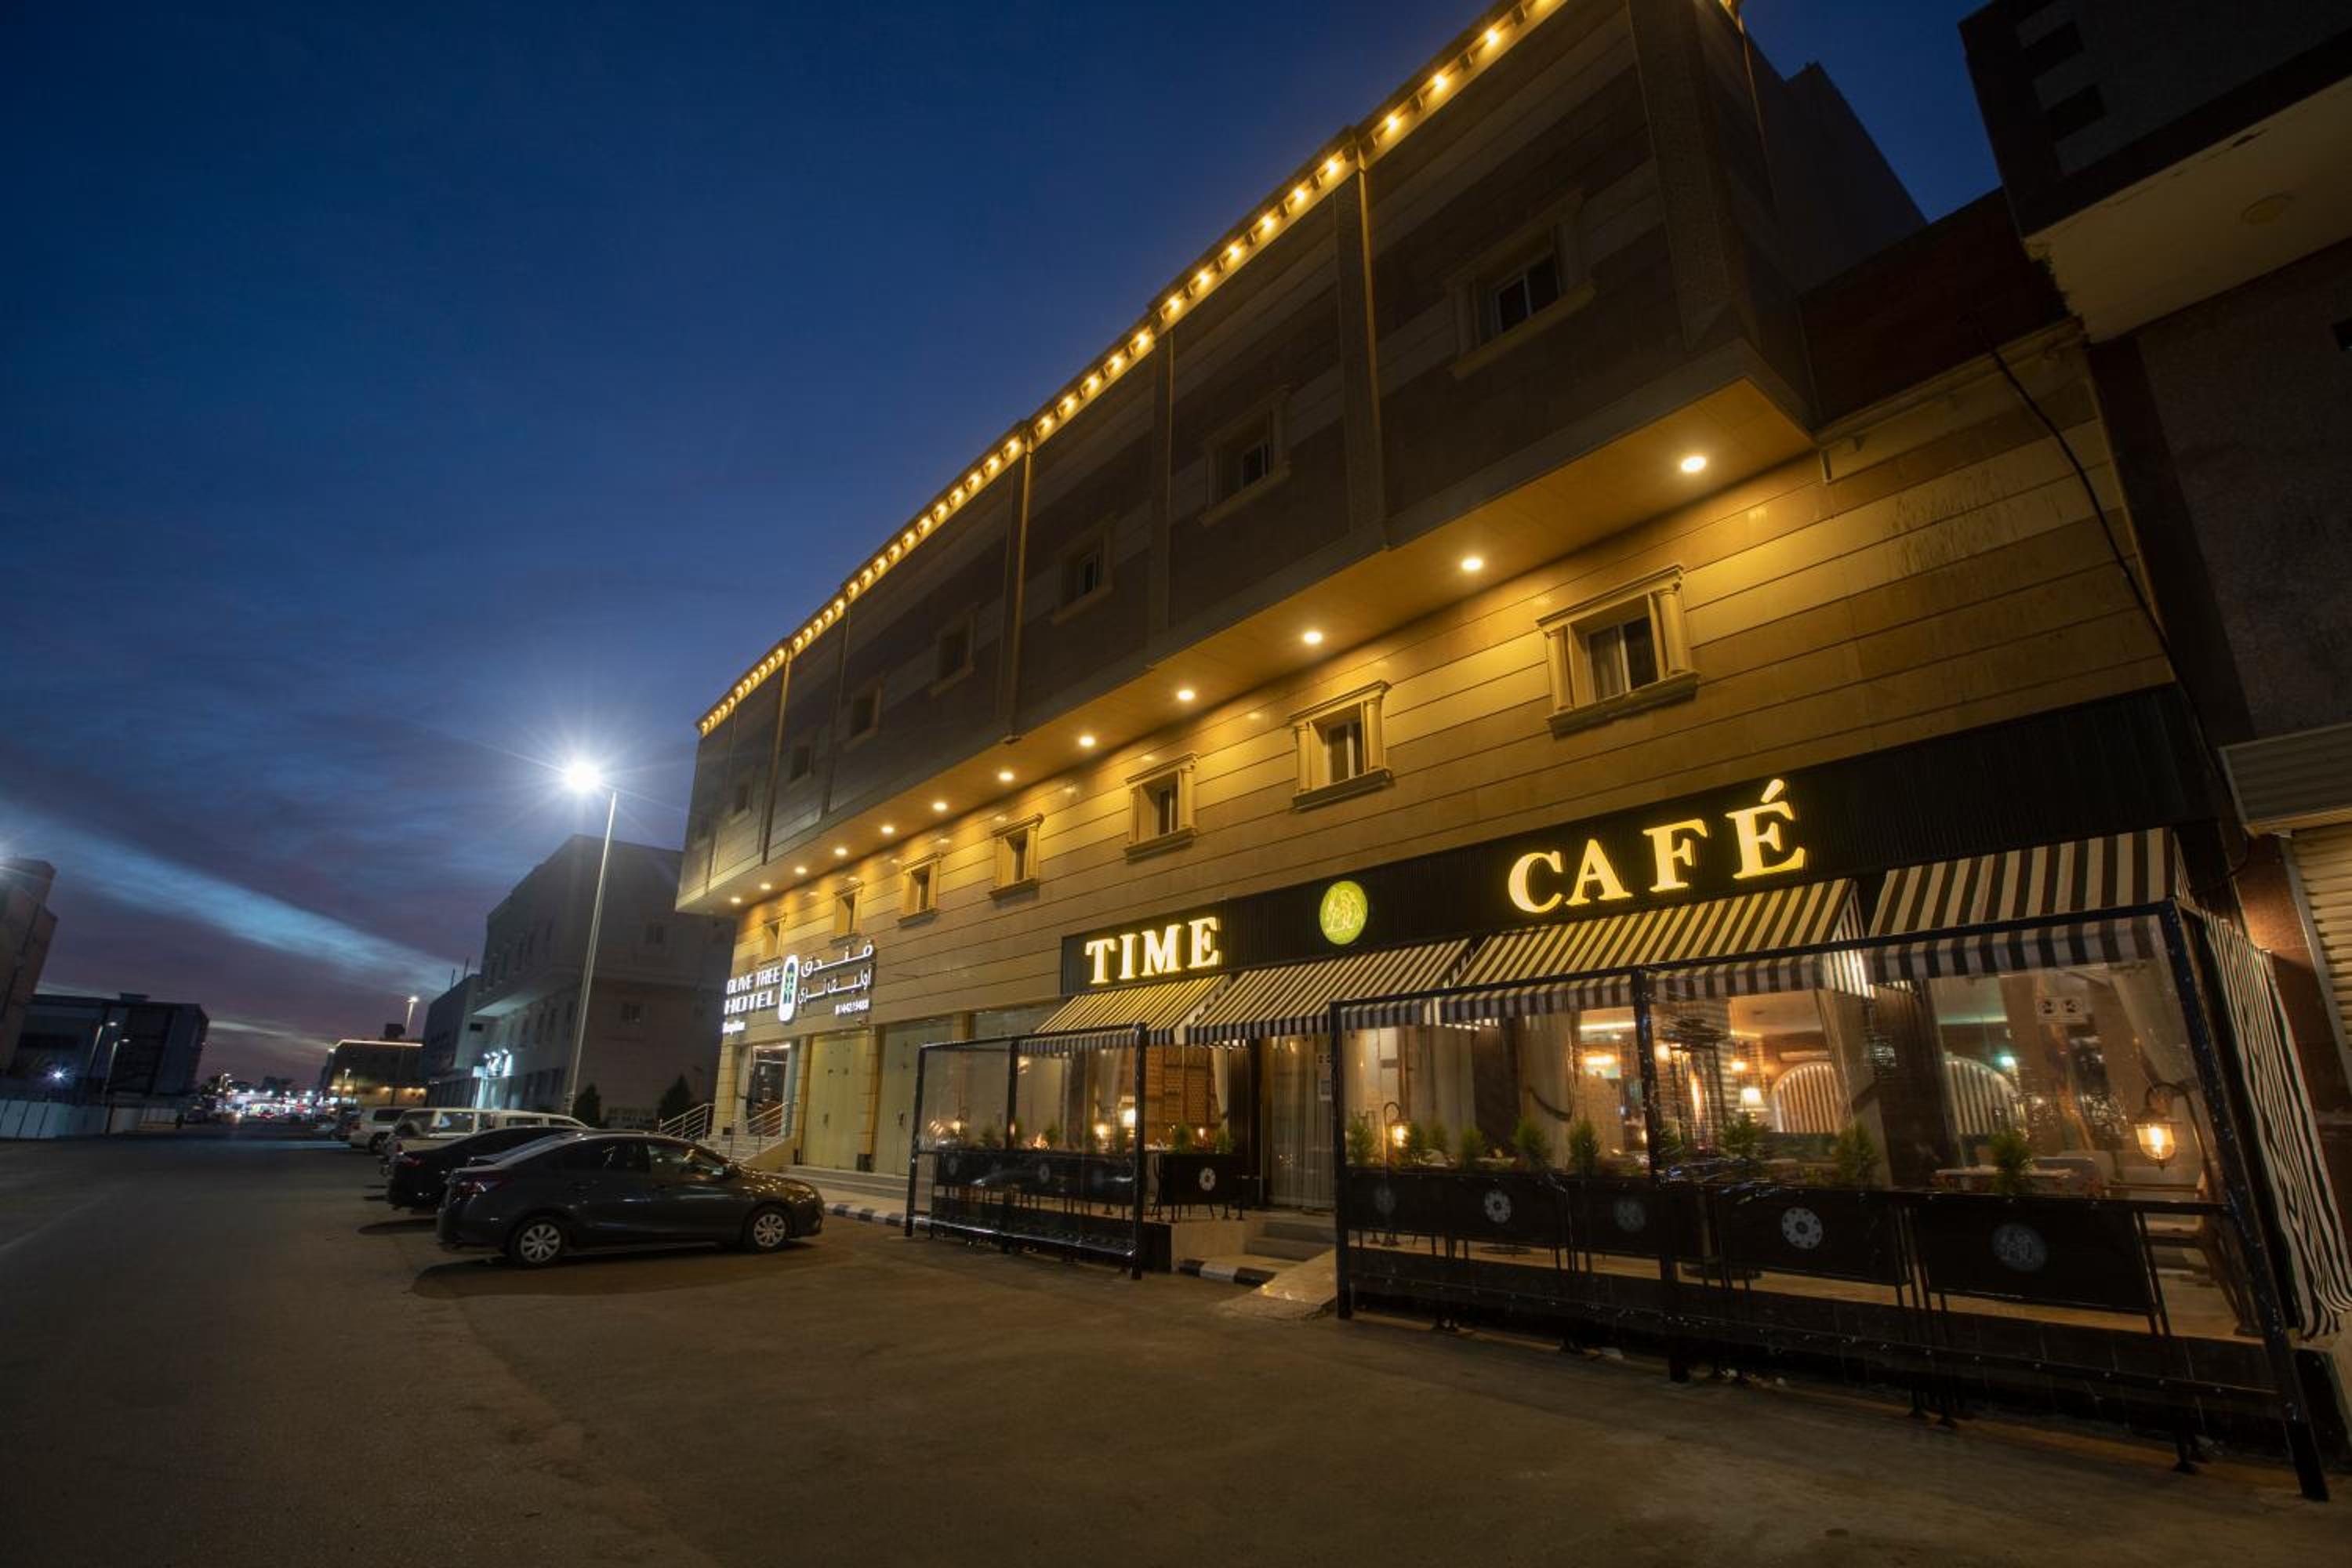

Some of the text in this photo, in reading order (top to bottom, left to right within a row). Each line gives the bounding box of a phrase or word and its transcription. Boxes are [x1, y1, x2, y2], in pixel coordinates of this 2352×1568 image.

[1085, 779, 1806, 984] TIME CAFÉ
[800, 940, 873, 978] فندق
[727, 967, 780, 994] OLIVE TREE
[724, 990, 777, 1015] HOTEL
